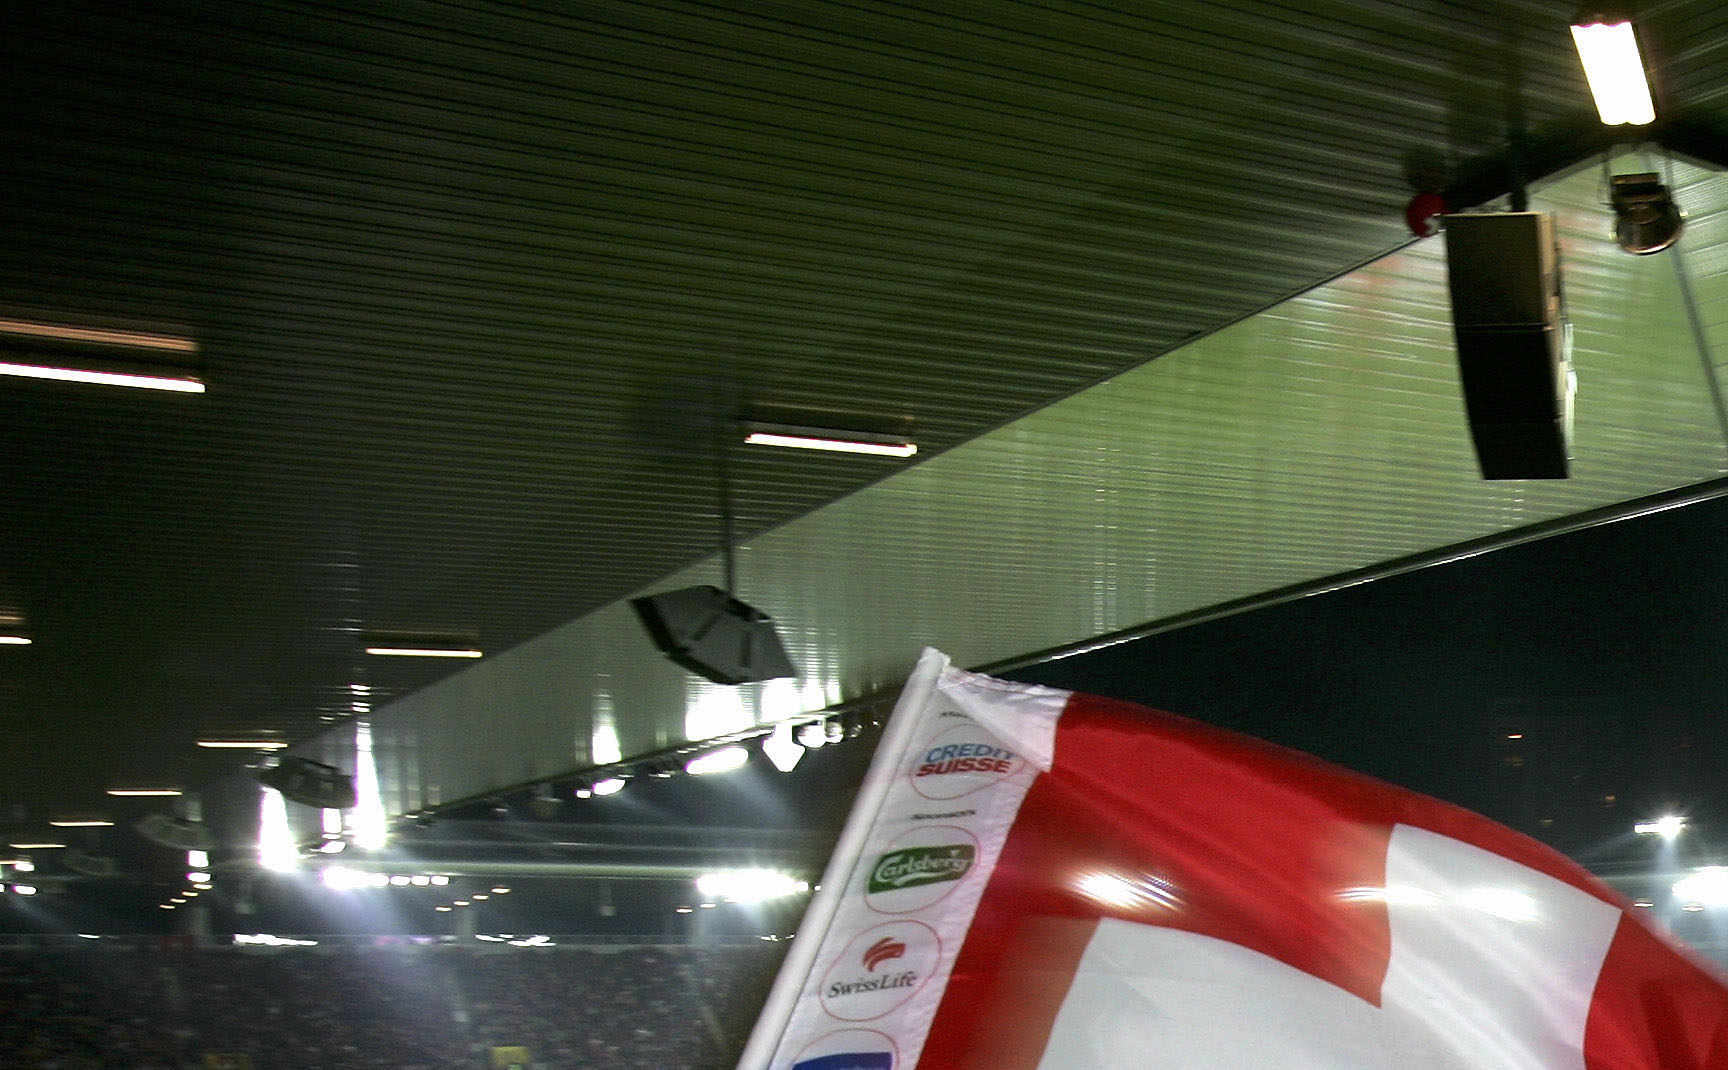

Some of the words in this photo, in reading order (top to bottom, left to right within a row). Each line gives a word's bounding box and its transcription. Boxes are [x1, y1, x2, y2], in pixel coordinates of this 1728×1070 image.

[924, 743, 1016, 763] CREDIT
[915, 757, 1011, 777] SUISSE
[875, 852, 974, 882] Carlsberg
